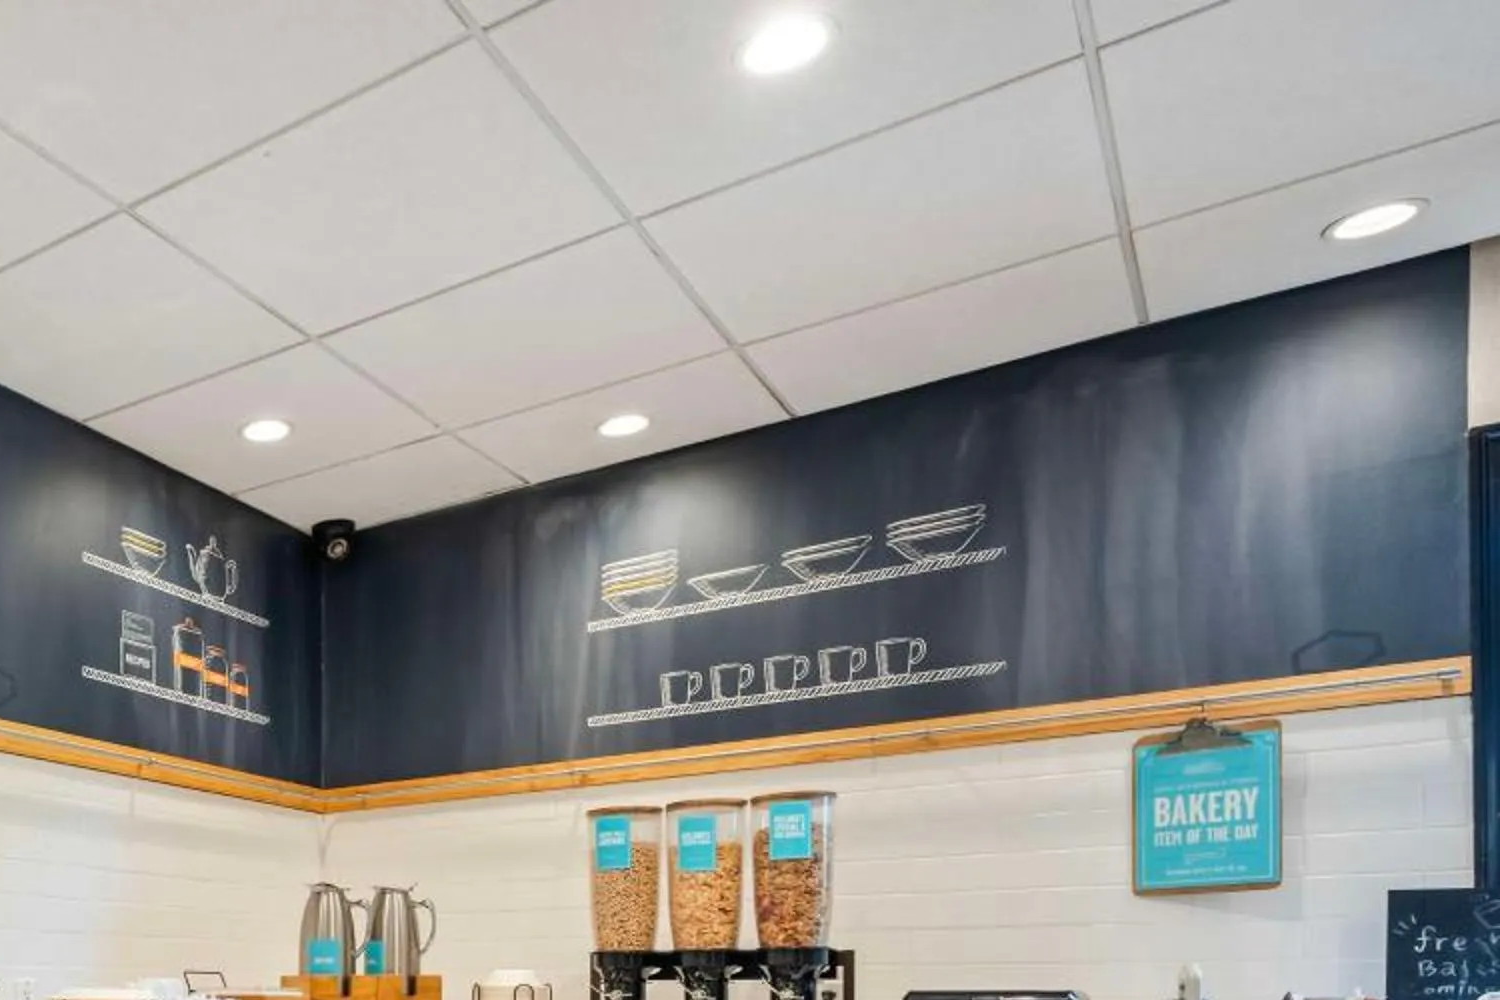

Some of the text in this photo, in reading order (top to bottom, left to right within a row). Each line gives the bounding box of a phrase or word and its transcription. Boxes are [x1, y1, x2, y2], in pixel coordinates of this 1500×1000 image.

[1154, 785, 1260, 828] BAKERY
[1154, 823, 1259, 848] ITEM OF THE DAY
